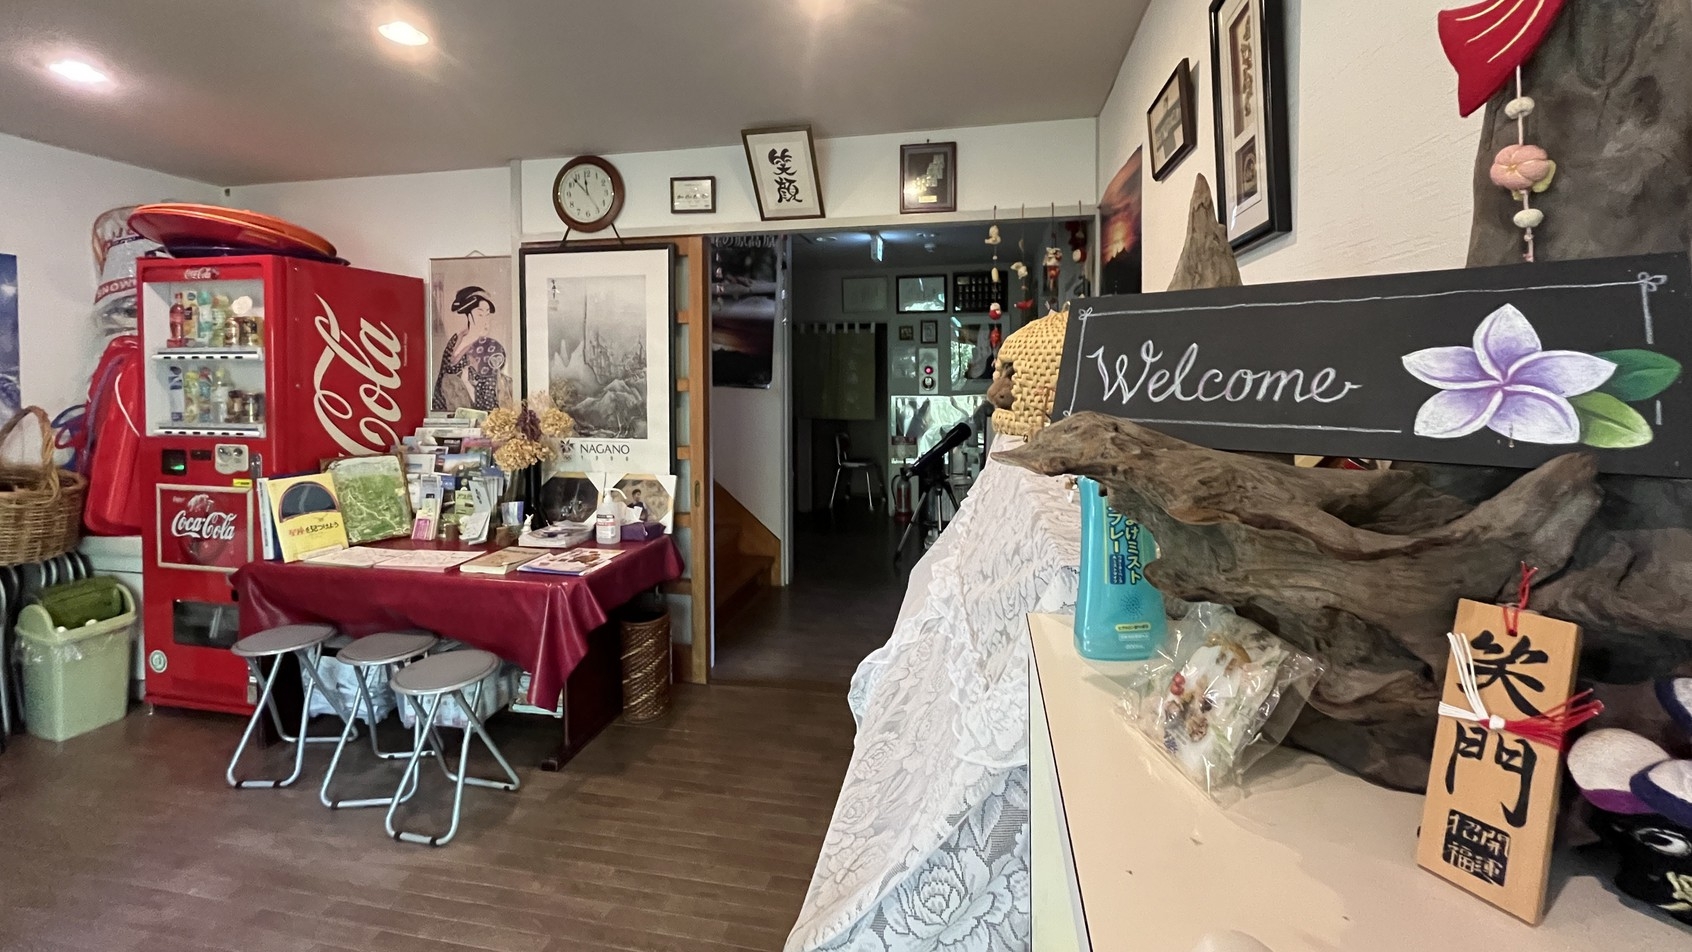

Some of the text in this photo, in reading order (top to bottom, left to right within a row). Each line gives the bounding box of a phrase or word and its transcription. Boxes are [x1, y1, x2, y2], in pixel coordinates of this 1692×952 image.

[1085, 339, 1363, 406] Welcome
[579, 443, 631, 455] NAGANO
[171, 509, 238, 541] Coca-Cola
[1444, 629, 1549, 829] 笑門
